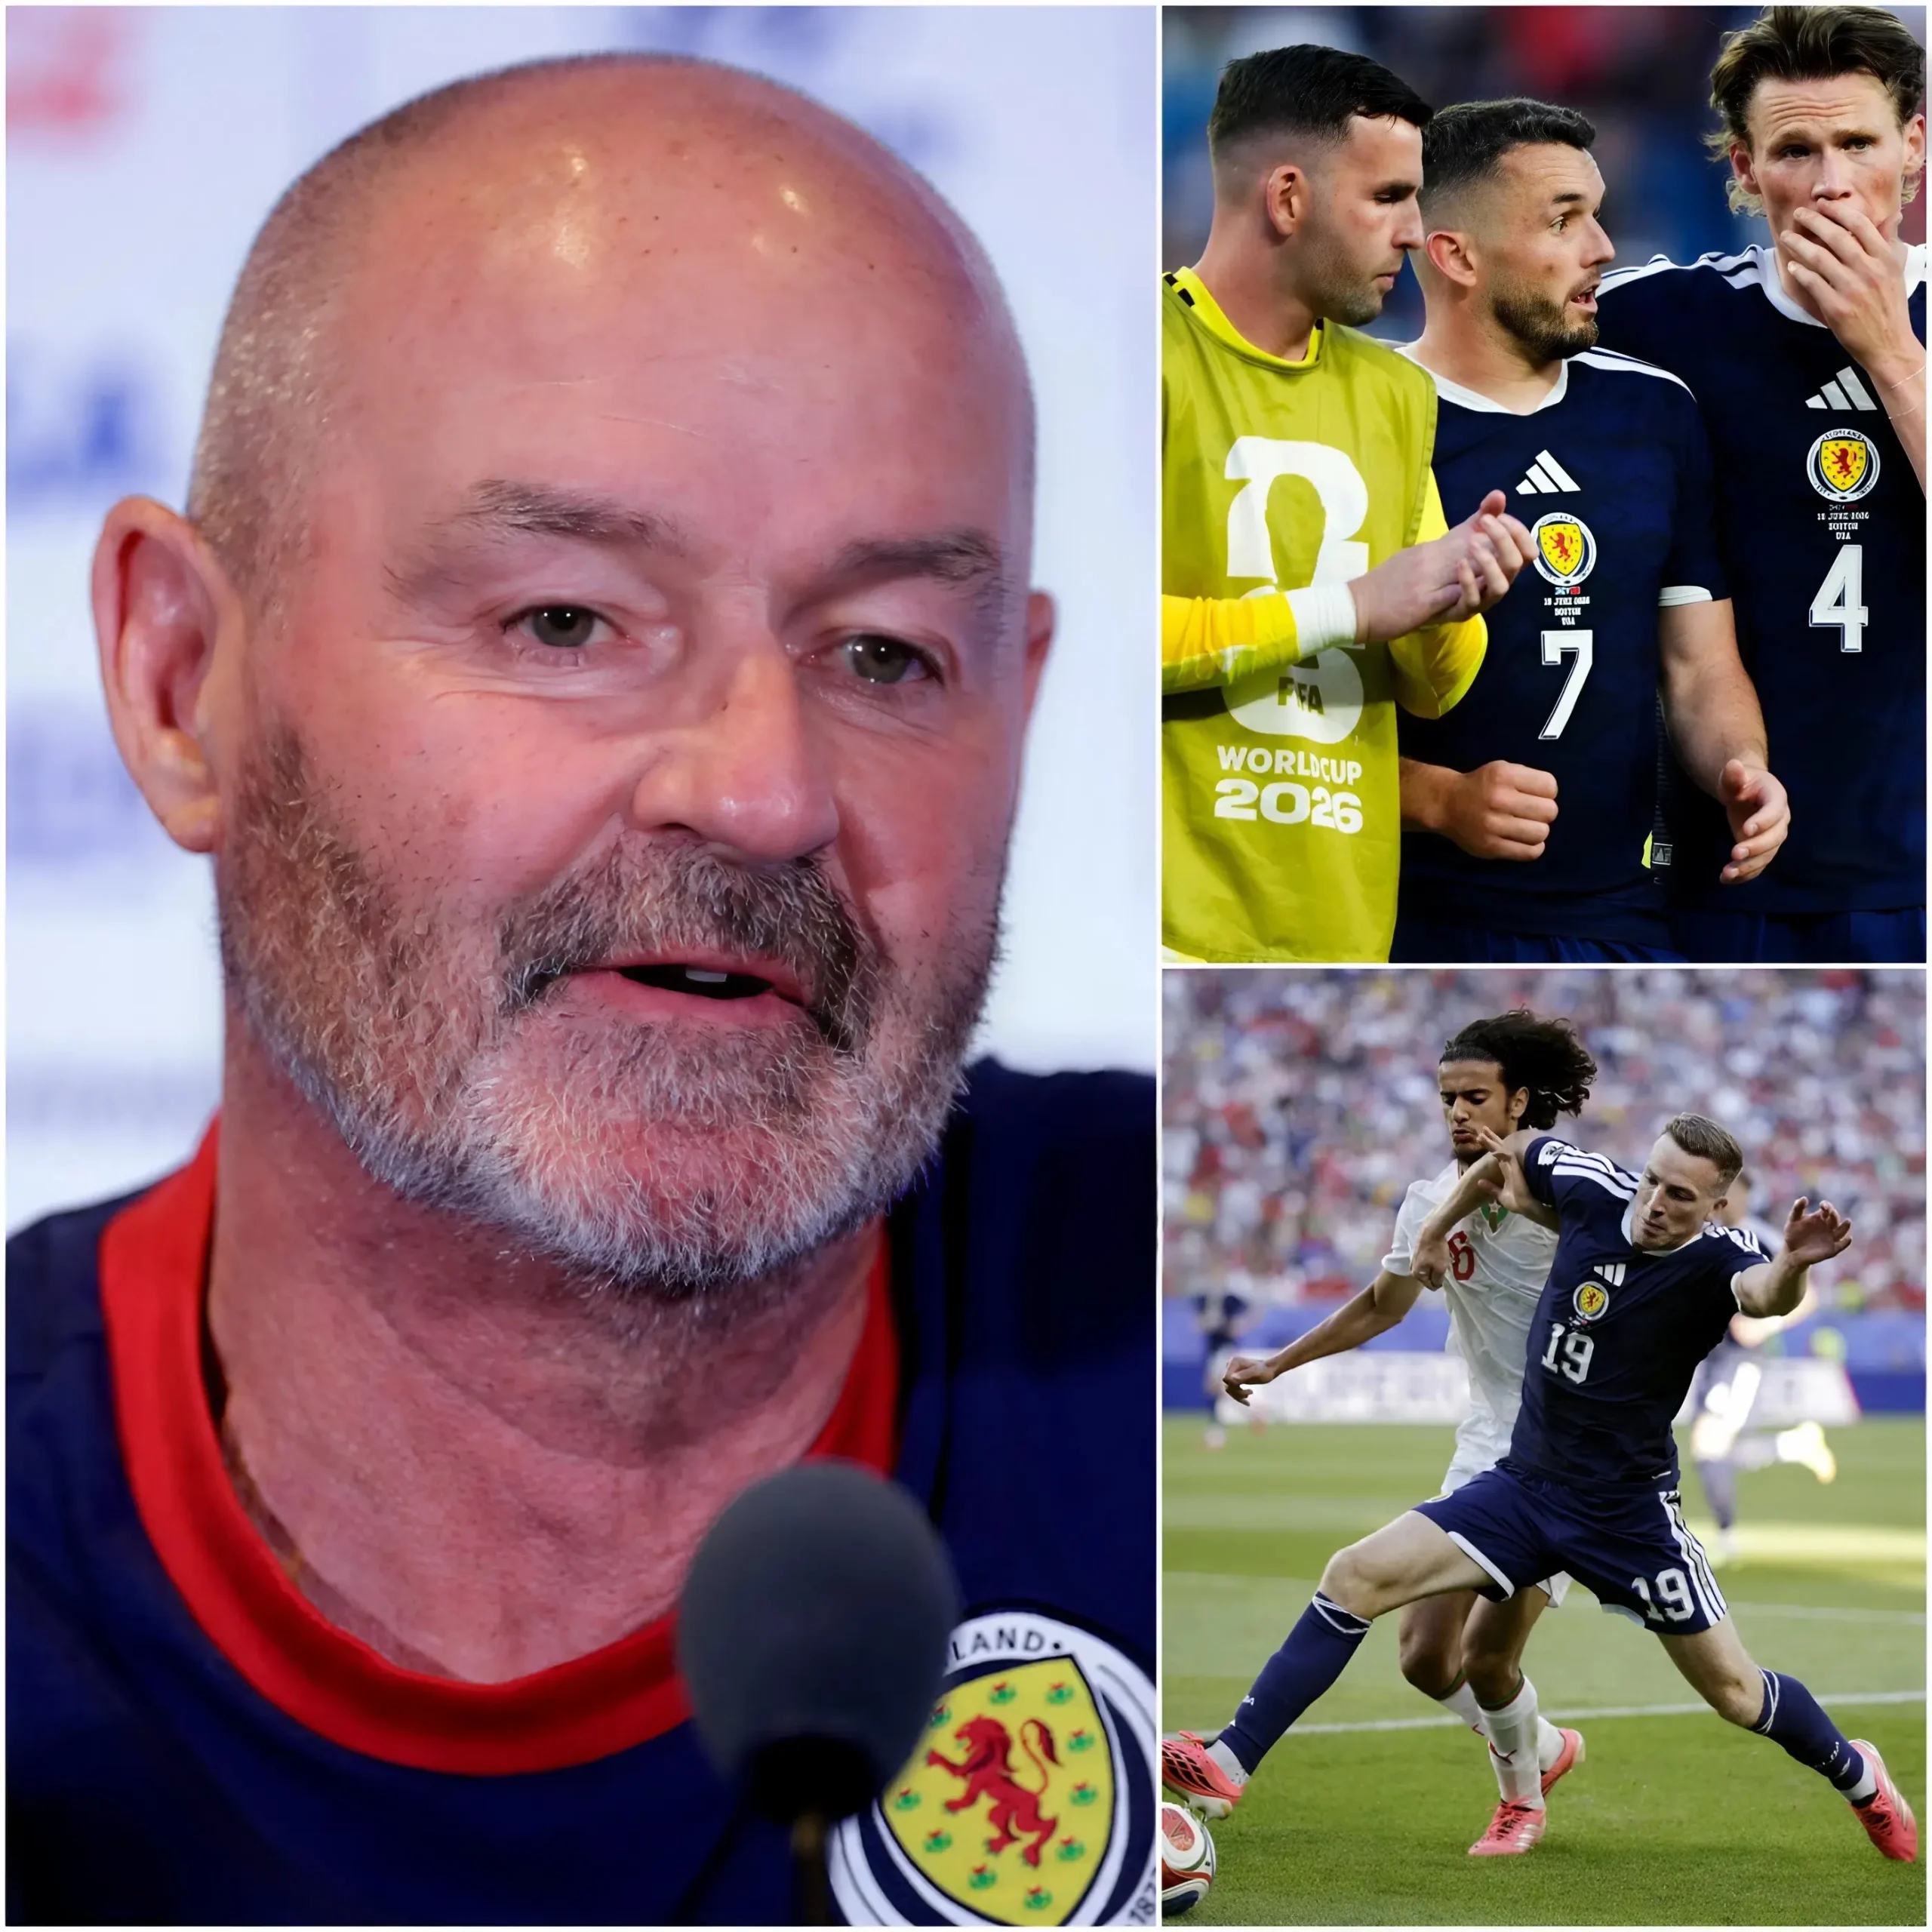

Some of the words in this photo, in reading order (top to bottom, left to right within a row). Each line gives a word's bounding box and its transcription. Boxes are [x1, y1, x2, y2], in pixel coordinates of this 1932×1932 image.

[1808, 544, 1869, 653] 4
[1538, 629, 1593, 740] 7
[1217, 745, 1321, 778] WORLD
[1321, 756, 1362, 786] CUP
[1214, 778, 1364, 834] 2026
[1541, 1322, 1595, 1385] 19
[1631, 1567, 1695, 1623] 19
